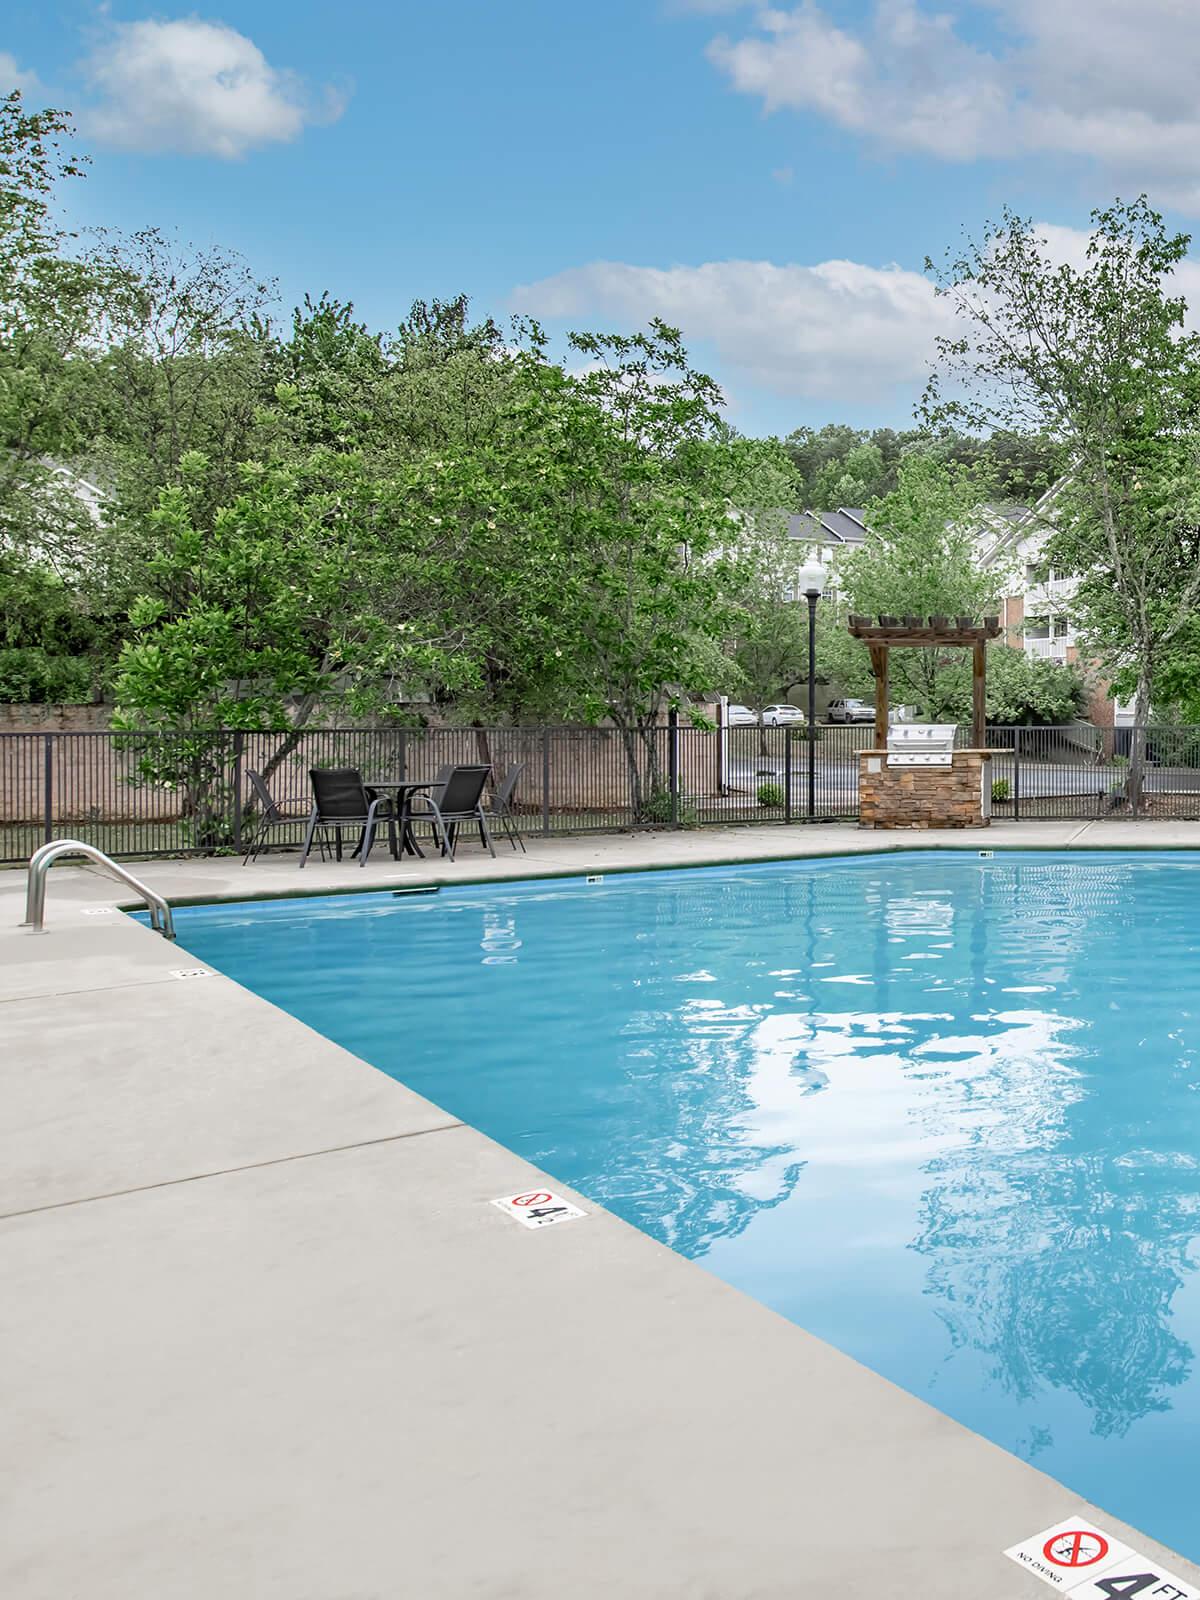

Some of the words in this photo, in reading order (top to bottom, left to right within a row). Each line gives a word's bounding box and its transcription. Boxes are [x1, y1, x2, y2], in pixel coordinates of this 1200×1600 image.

[526, 1207, 568, 1219] 4
[1016, 1551, 1033, 1563] NO
[1031, 1561, 1063, 1583] DIVING
[1093, 1573, 1161, 1600] 4
[1151, 1583, 1188, 1600] FT
